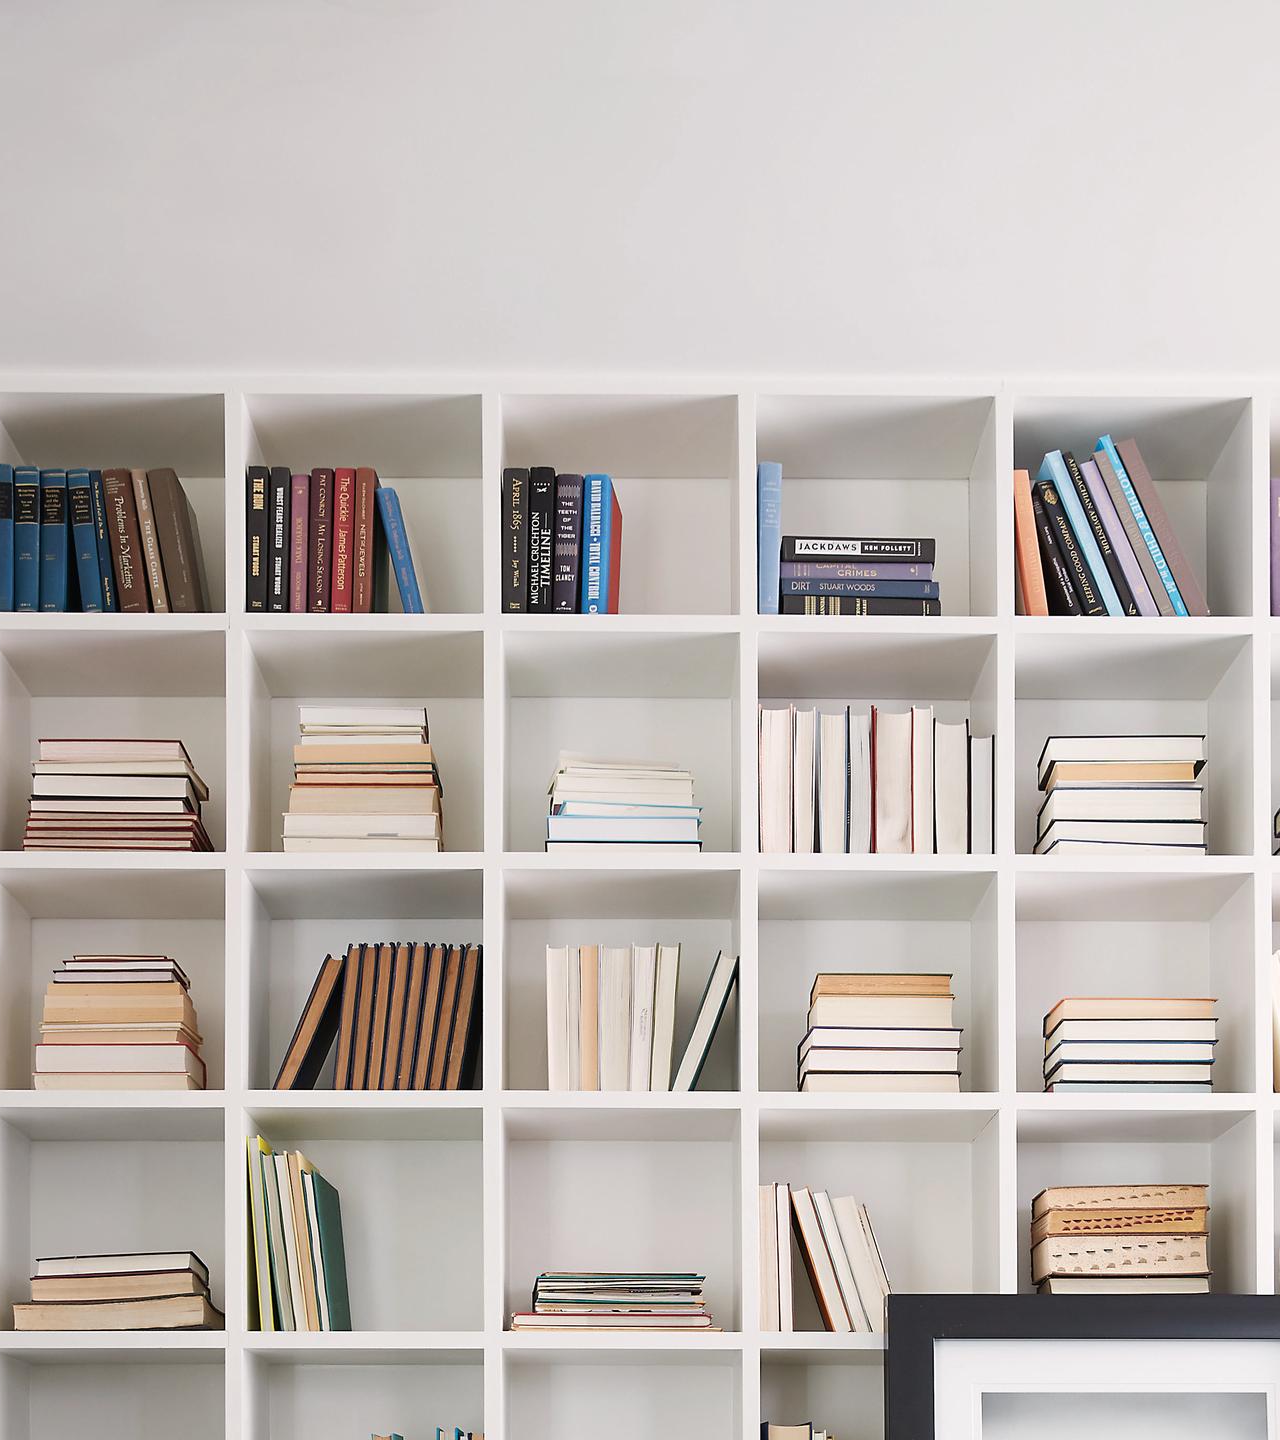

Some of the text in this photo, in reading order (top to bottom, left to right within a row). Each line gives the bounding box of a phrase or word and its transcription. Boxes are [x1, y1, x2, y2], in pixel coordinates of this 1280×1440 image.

[253, 478, 264, 510] THE RUN
[339, 477, 350, 522] The Quickie
[510, 478, 522, 530] APRIL 1865
[1069, 458, 1112, 555] APPALACHIAN ADVENTURE
[1116, 469, 1144, 520] MOTHER
[115, 496, 126, 535] Problems
[275, 487, 284, 548] WORST FEARS REALIZED
[318, 524, 326, 535] MY
[120, 535, 128, 544] In
[252, 535, 260, 576] STUART WOODS
[317, 538, 325, 564] LOSING
[531, 512, 540, 604] MICHAEL CRICHTON
[540, 528, 551, 588] TIMELINE
[589, 542, 600, 565] TOTAL
[799, 543, 857, 551] JACKDAWS
[1144, 532, 1167, 570] CHILD
[120, 545, 132, 589] Marketing
[151, 562, 159, 588] CASTLE
[337, 529, 348, 590] James Patterson
[556, 573, 574, 582] CLANCY
[1056, 515, 1096, 604] KEEPING GOOD COMPANY
[1160, 569, 1167, 577] in
[588, 566, 600, 600] CONTROL
[792, 582, 810, 590] DIRT
[820, 583, 844, 591] STUART
[1162, 576, 1176, 593] Art
